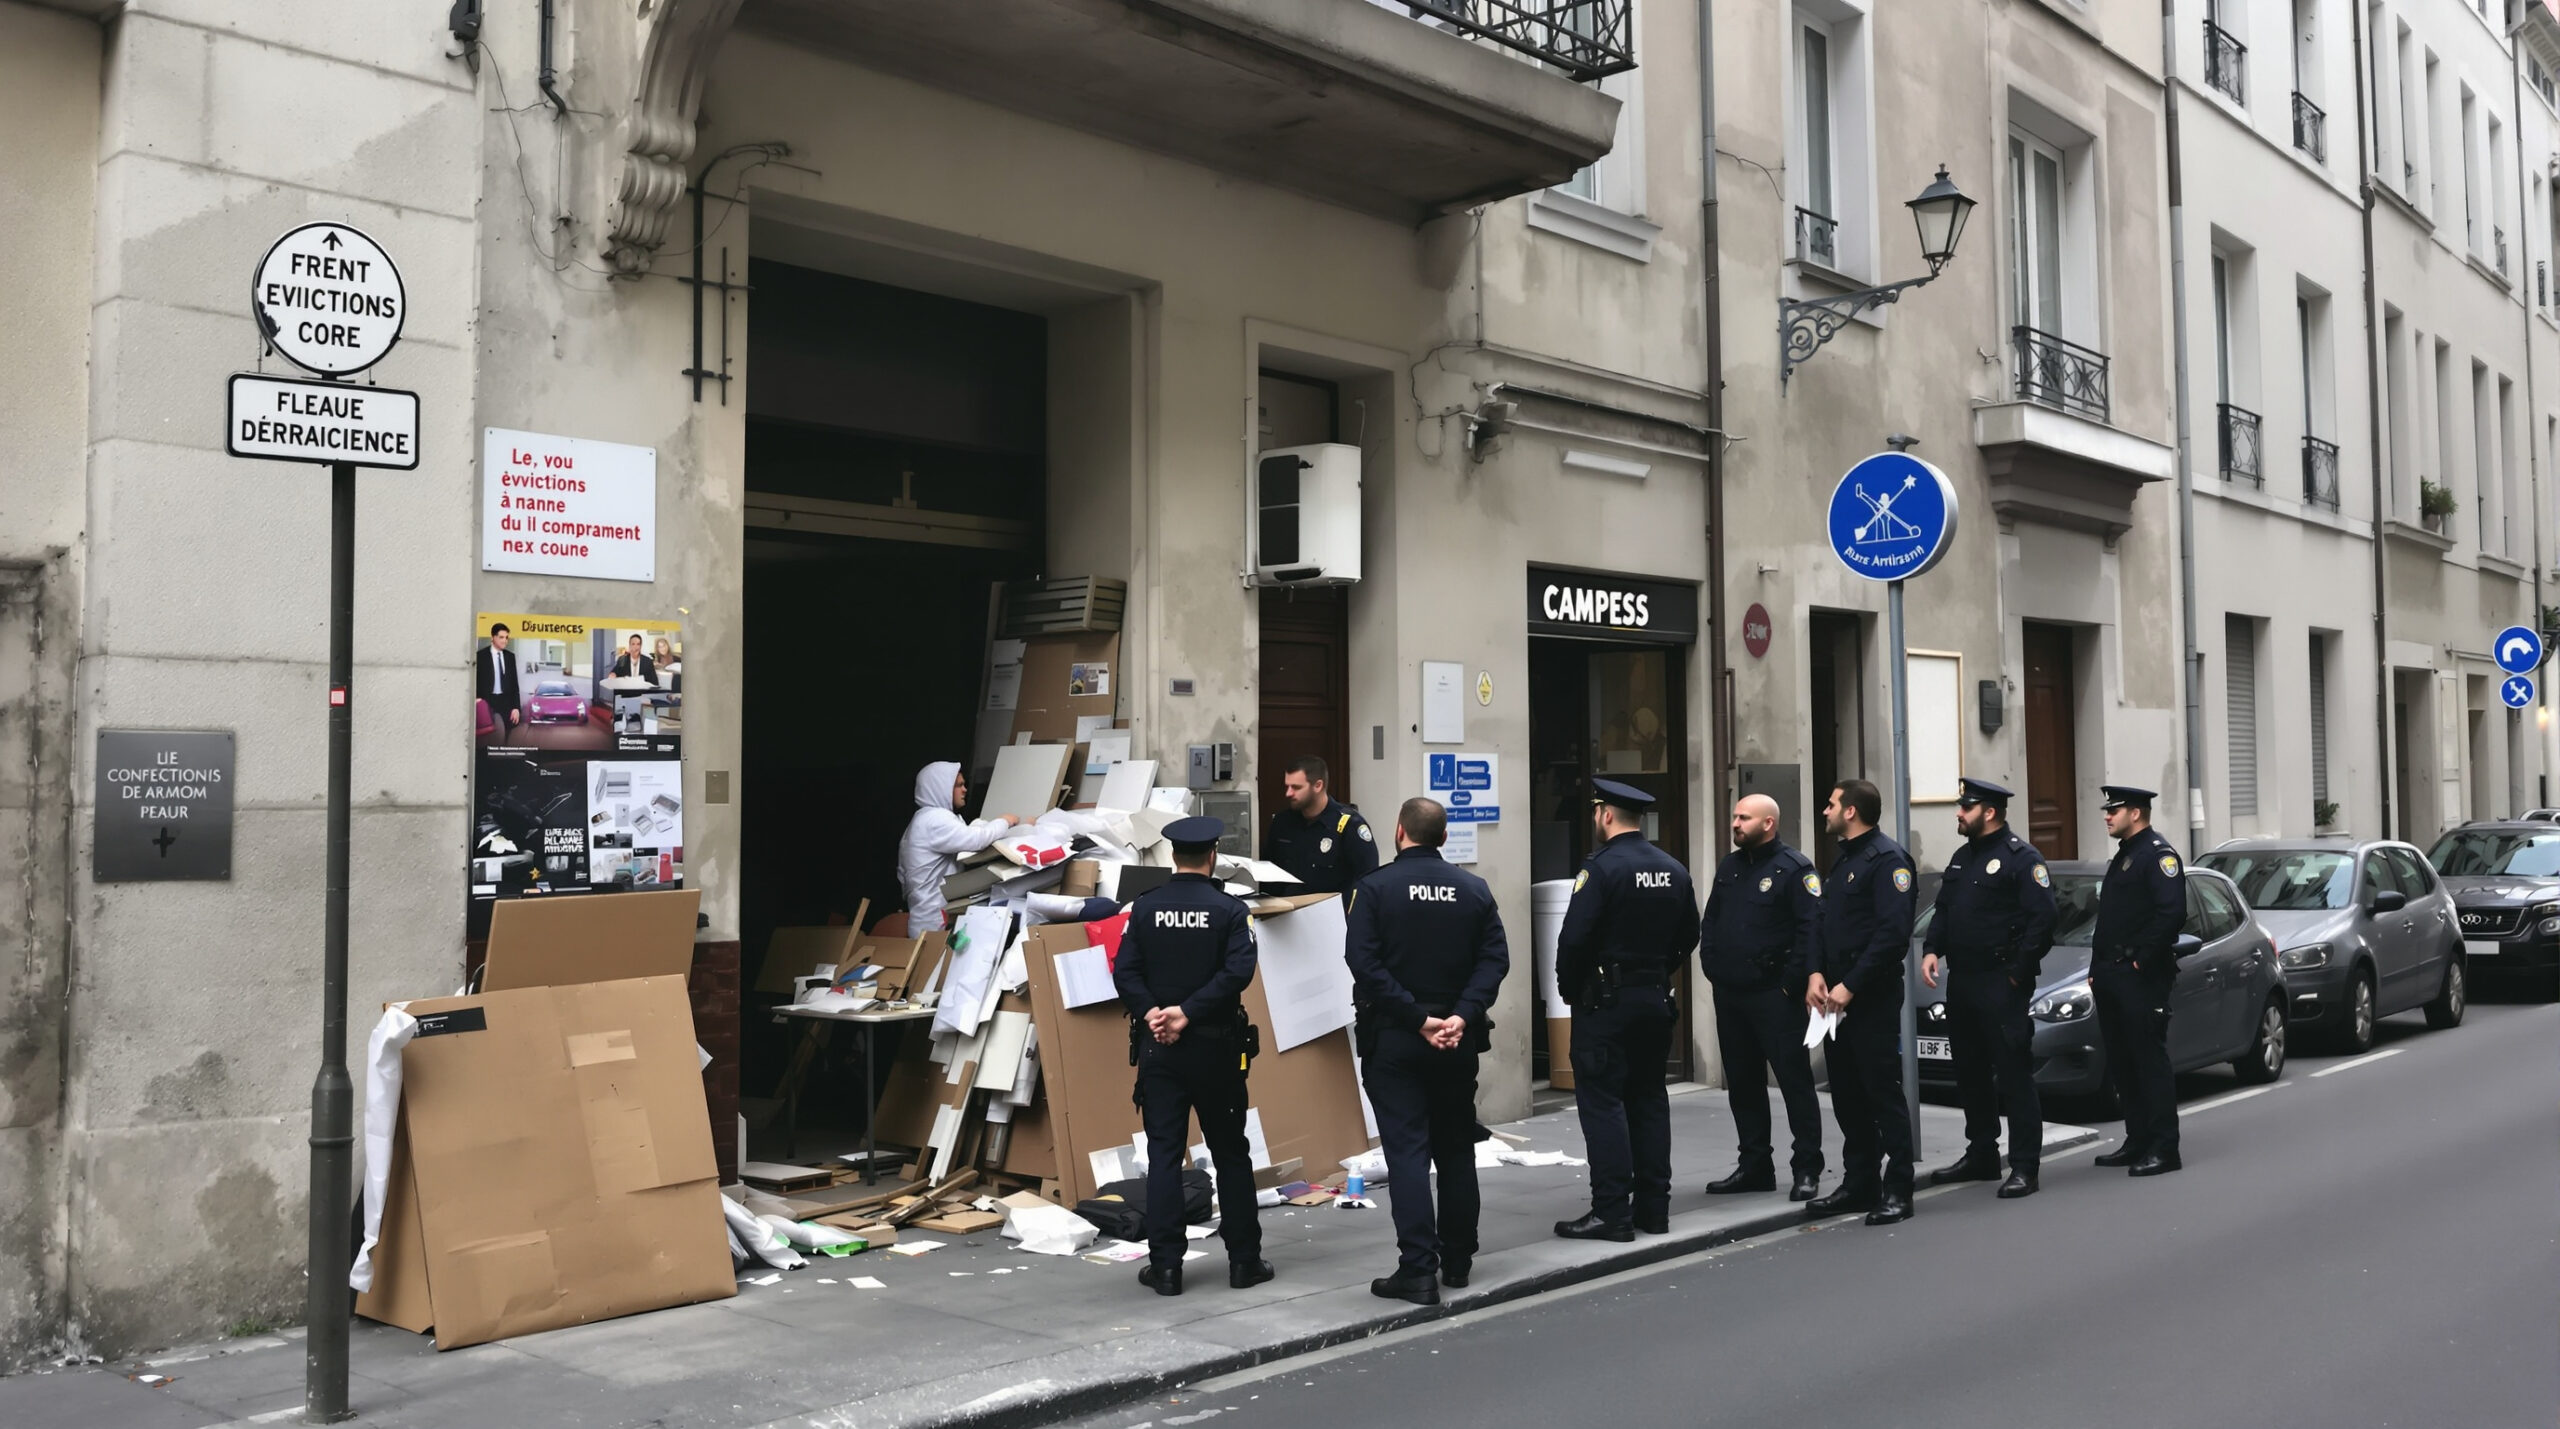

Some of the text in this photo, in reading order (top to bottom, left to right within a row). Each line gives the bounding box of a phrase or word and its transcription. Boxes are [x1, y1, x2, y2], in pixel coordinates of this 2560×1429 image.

[291, 253, 371, 283] FRENT
[266, 283, 396, 319] EVIICTIONS
[298, 321, 361, 349] CORE
[277, 391, 364, 420] FLEAUE
[241, 415, 409, 455] DÉRRAICIENCE
[512, 448, 573, 469] Le, vou
[515, 497, 566, 513] nanne
[501, 514, 641, 541] du il comprament
[503, 539, 590, 557] nex coune
[1543, 584, 1649, 627] CAMPESS
[122, 785, 207, 799] DE ARMOM
[140, 805, 189, 819] PEAUR
[1635, 872, 1672, 888] POLICE
[1408, 884, 1457, 902] POLICE
[1155, 910, 1210, 928] POLICIE
